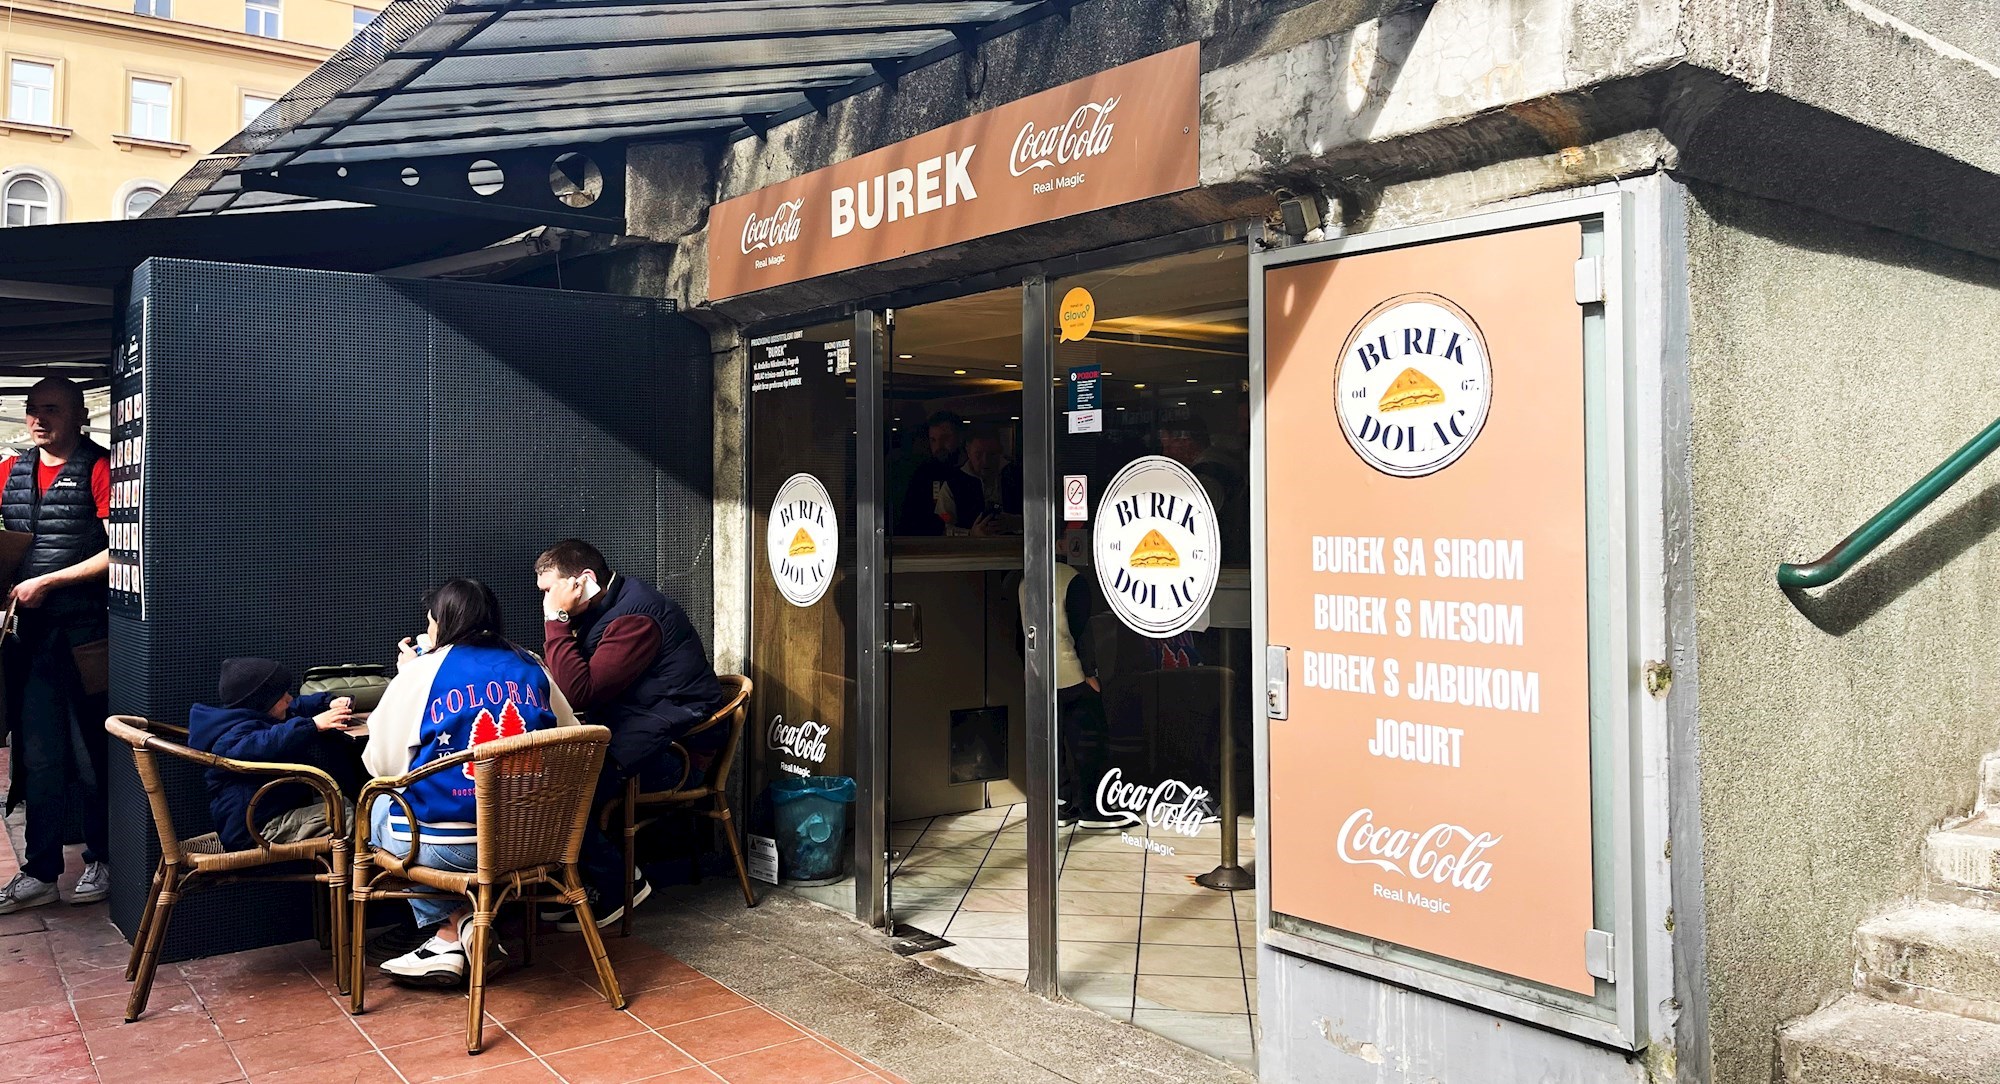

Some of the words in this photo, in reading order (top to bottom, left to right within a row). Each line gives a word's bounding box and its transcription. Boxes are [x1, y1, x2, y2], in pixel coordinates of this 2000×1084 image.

[1009, 94, 1122, 178] Coca-Cola
[830, 144, 978, 238] BUREK
[1033, 178, 1054, 195] Real
[1056, 172, 1085, 192] Magic
[740, 196, 805, 255] Coca-Cola
[755, 258, 768, 269] Real
[768, 253, 786, 267] Magic
[1064, 310, 1086, 321] Glovo
[1357, 327, 1472, 372] BUREK
[1352, 387, 1366, 398] od
[1461, 379, 1480, 391] 67.
[1358, 410, 1472, 452] DOLAC
[780, 500, 828, 528] BUREK
[1116, 492, 1202, 536] BUREK
[1110, 540, 1121, 551] od
[1192, 549, 1206, 561] 67.
[1312, 536, 1386, 574] BUREK
[1393, 536, 1426, 577] SA
[1434, 538, 1524, 580] SIROM
[1114, 567, 1201, 610] DOLAC
[1314, 594, 1387, 636] BUREK
[1396, 598, 1411, 638] S
[1420, 599, 1524, 646] MESOM
[1304, 650, 1376, 695] BUREK
[1383, 657, 1400, 698] S
[1408, 661, 1540, 713] JABUKOM
[767, 714, 830, 763] Coca-Cola
[1368, 717, 1464, 768] JOGURT
[781, 761, 792, 773] Real
[794, 765, 810, 778] Magic
[1096, 767, 1209, 837] Coca-Cola
[1121, 832, 1143, 848] Real
[1145, 838, 1175, 856] Magic
[1336, 807, 1503, 893] Coca-Cola
[1374, 883, 1404, 903] Real
[1408, 893, 1451, 913] Magic
